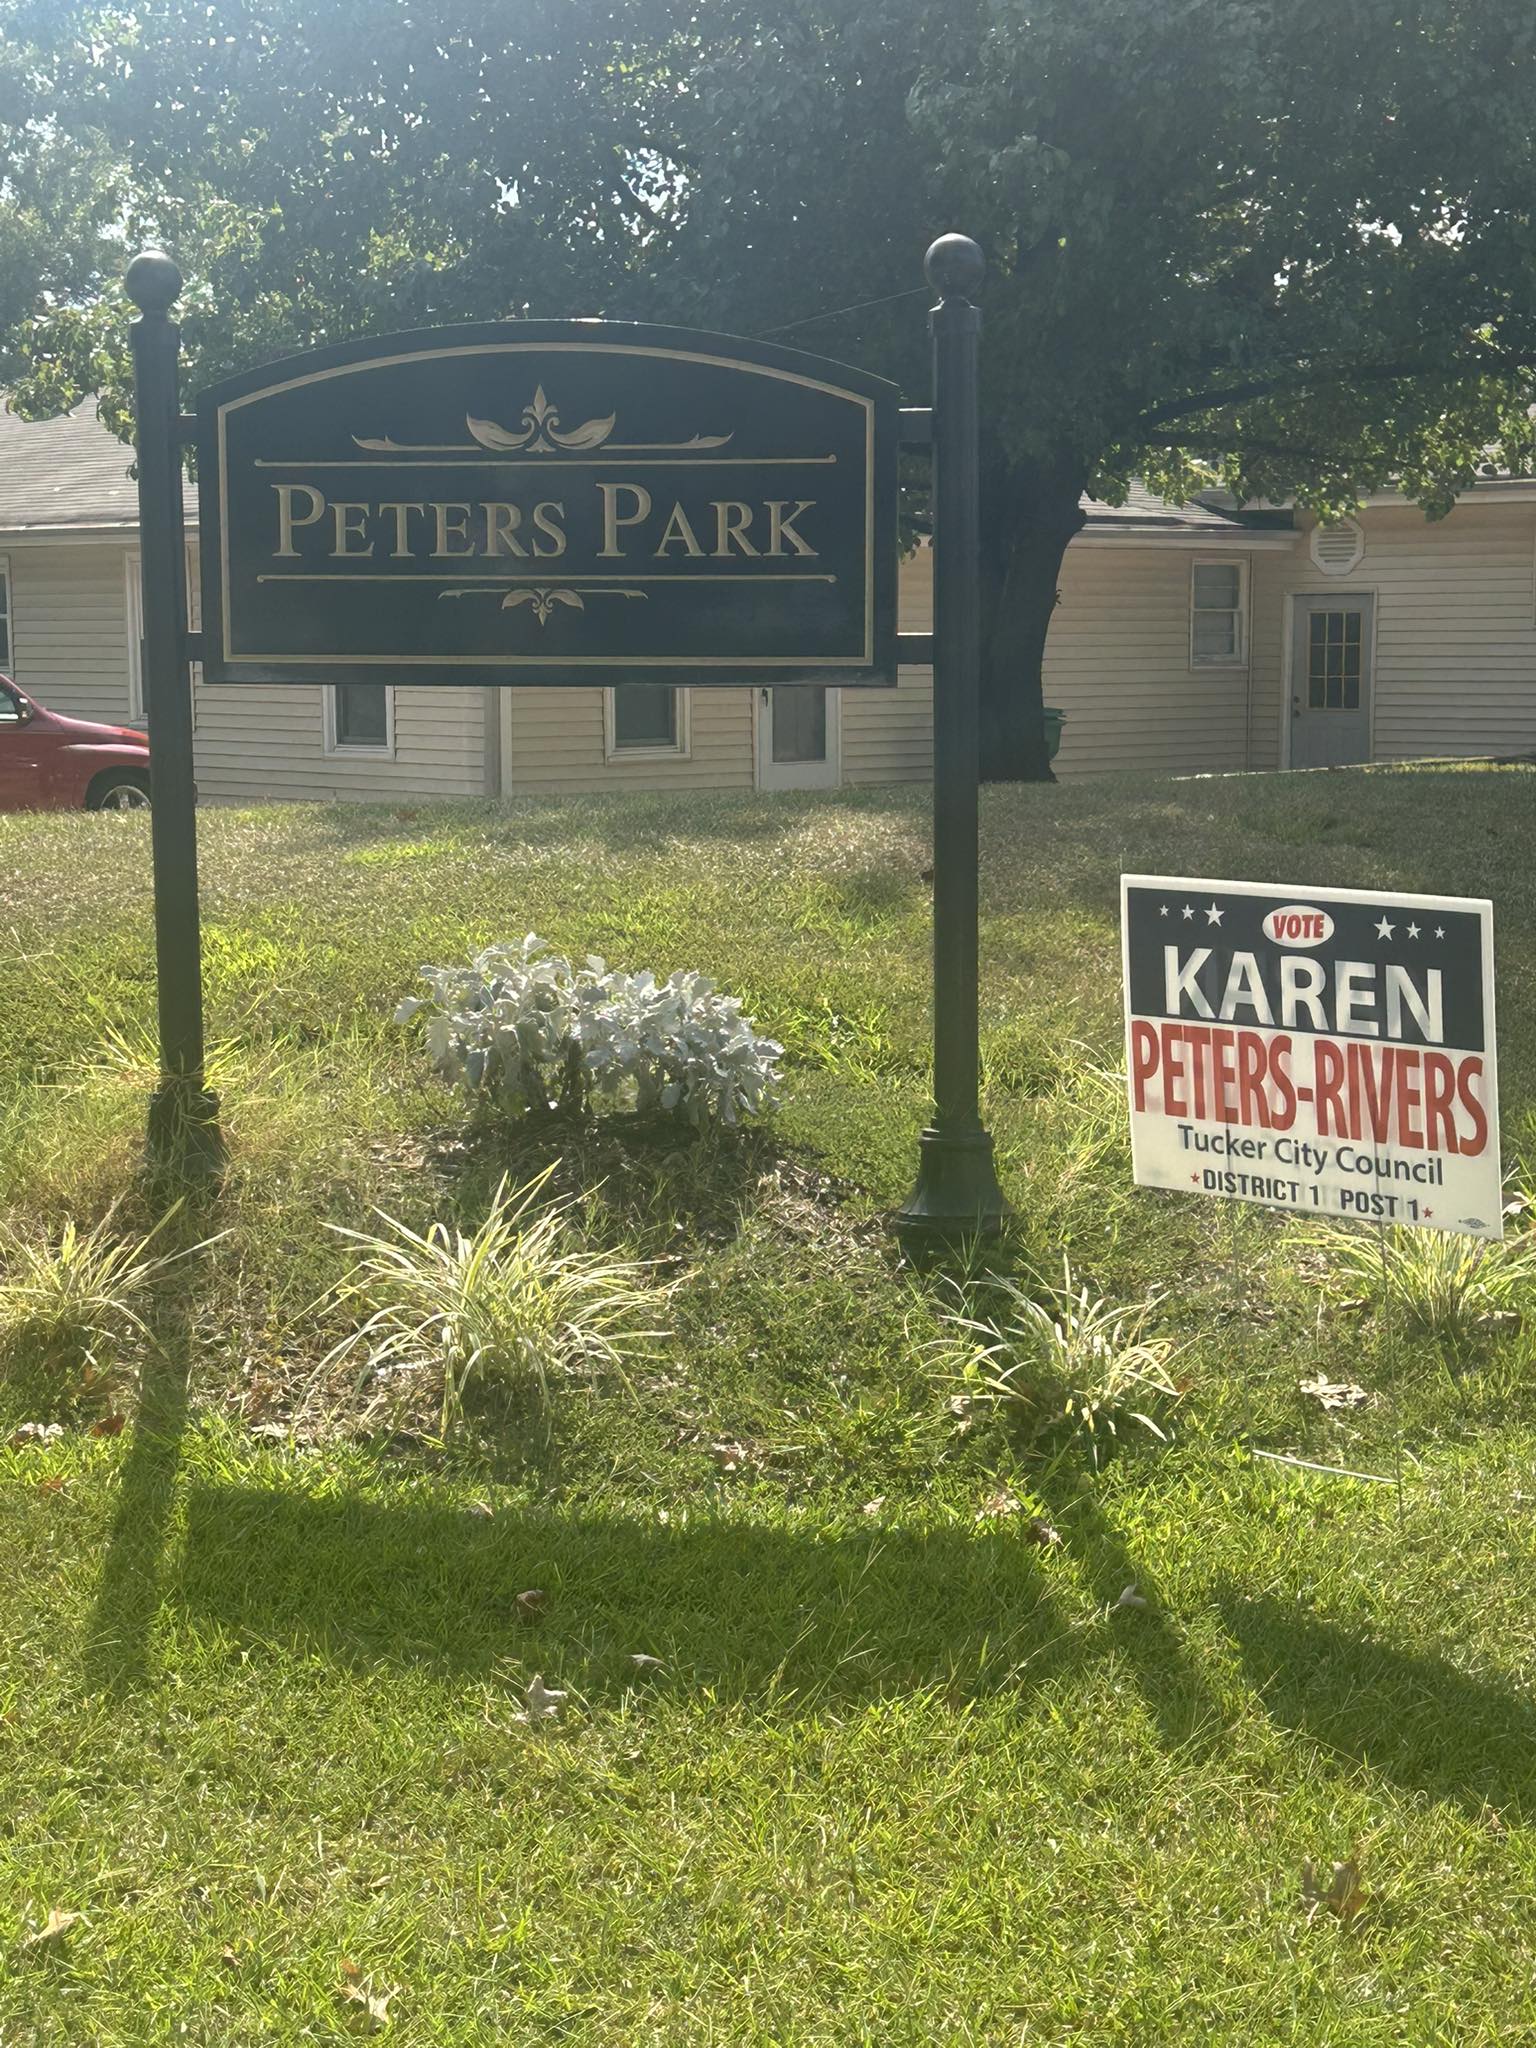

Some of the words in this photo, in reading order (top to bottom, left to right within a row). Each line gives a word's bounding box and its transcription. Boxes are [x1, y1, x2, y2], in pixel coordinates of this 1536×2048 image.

[271, 484, 567, 558] PETERS
[596, 483, 819, 557] PARK
[1272, 914, 1325, 939] VOTE
[1164, 945, 1444, 1044] KAREN
[1131, 1020, 1488, 1157] PETERS-RIVERS
[1177, 1124, 1267, 1160] Tucker
[1274, 1138, 1328, 1175] City
[1336, 1146, 1443, 1185] Council
[1203, 1169, 1300, 1203] DISTRICT
[1309, 1185, 1319, 1206] 1
[1340, 1189, 1399, 1218] POST
[1407, 1200, 1419, 1221] 1
